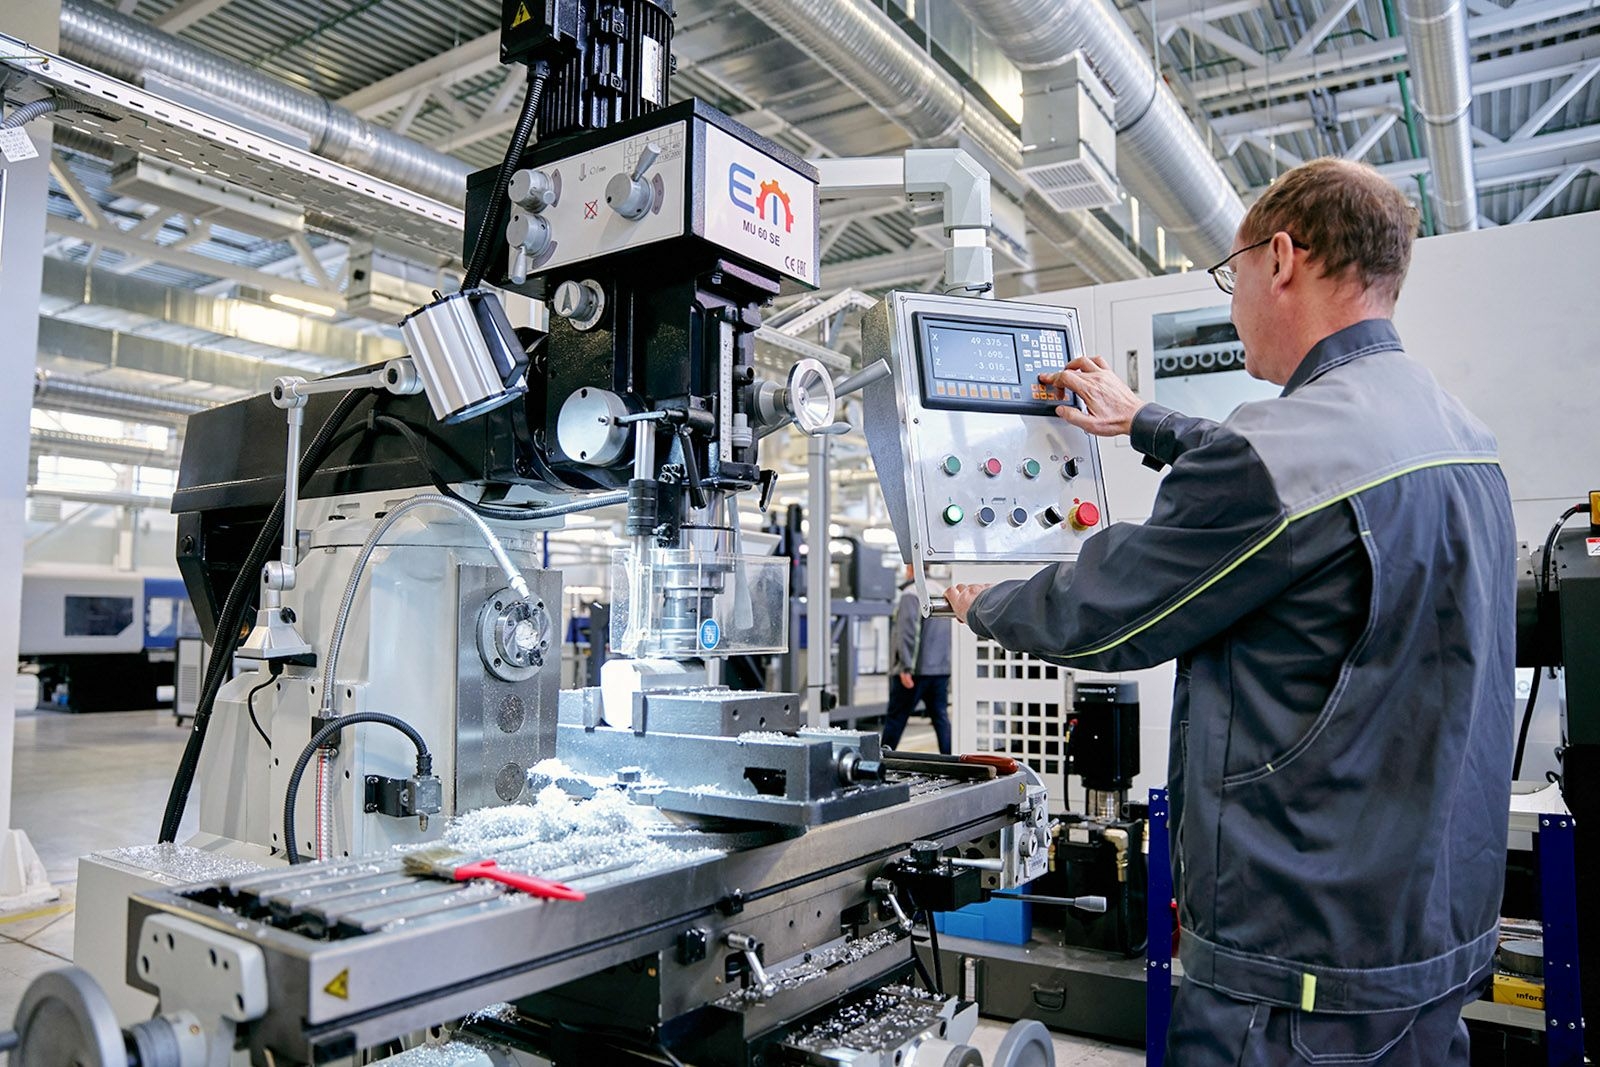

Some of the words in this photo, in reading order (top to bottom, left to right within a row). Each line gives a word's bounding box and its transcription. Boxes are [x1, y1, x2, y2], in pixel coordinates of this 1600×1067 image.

[743, 220, 756, 235] MU
[758, 227, 768, 240] 60
[769, 232, 780, 247] SE
[785, 256, 795, 272] CE
[932, 333, 938, 341] X
[970, 336, 1002, 347] 49.375
[973, 349, 1004, 359] -1.695
[936, 358, 941, 366] Z
[975, 361, 1005, 371] -3.015
